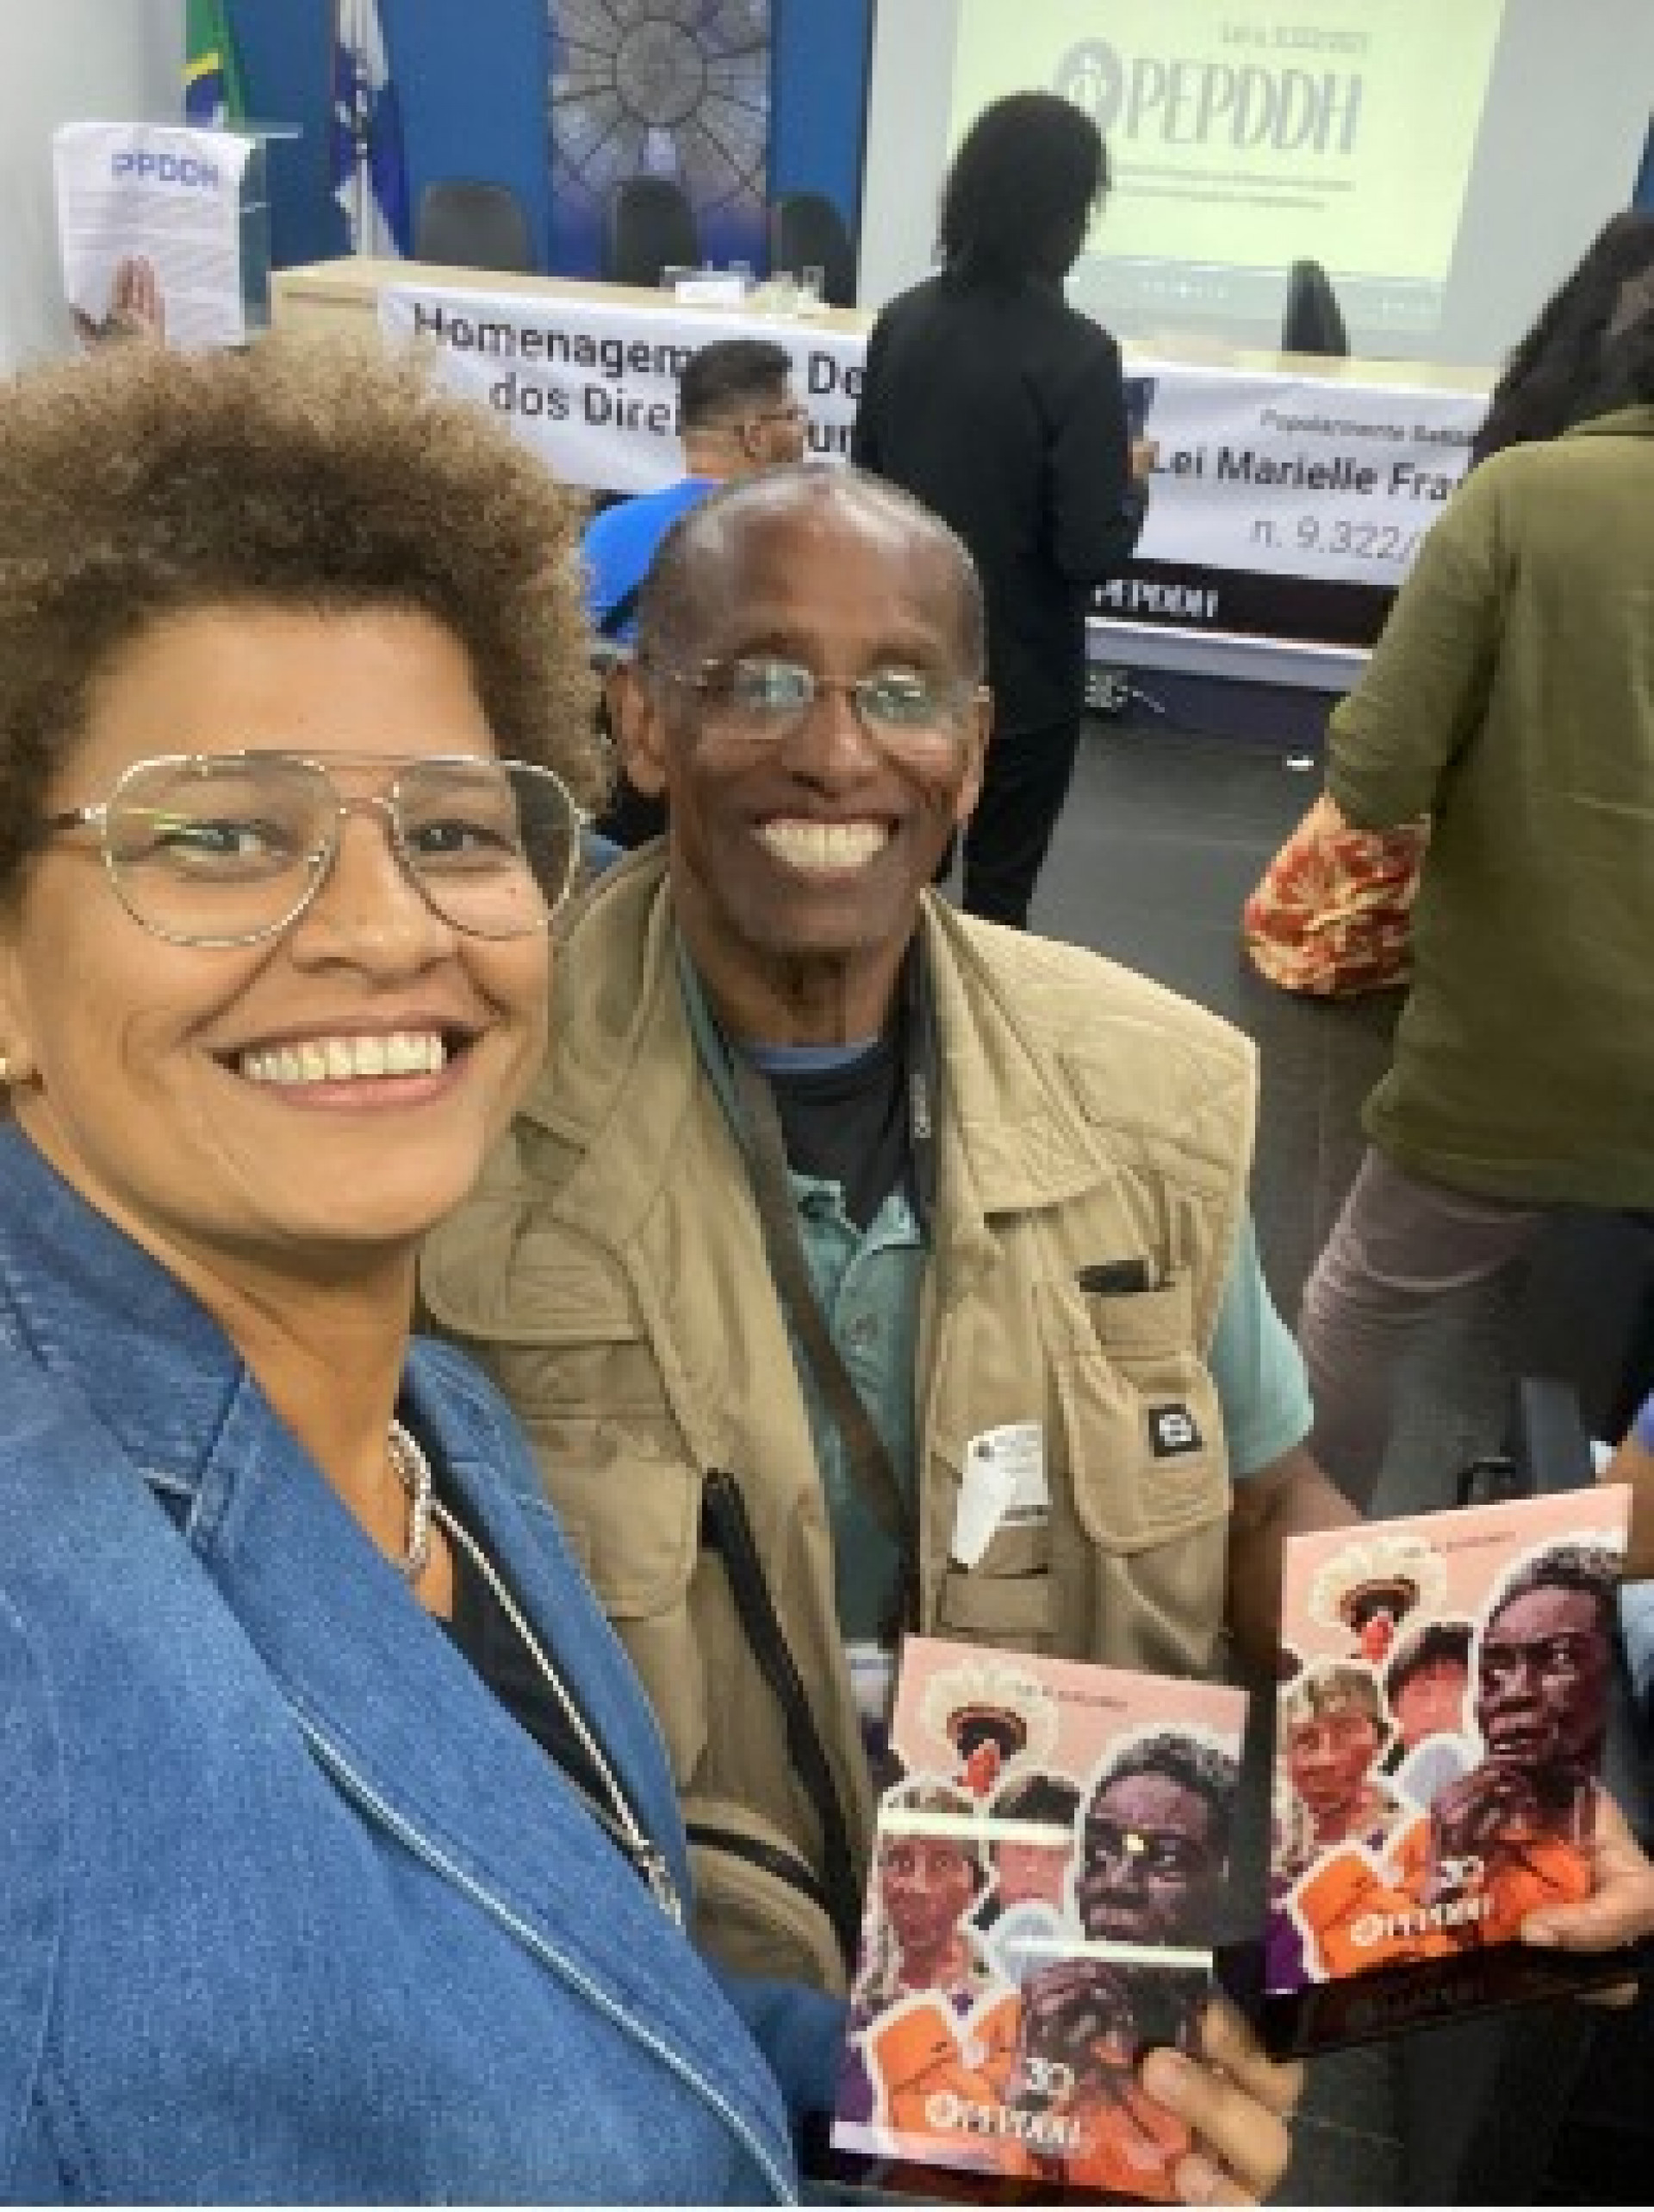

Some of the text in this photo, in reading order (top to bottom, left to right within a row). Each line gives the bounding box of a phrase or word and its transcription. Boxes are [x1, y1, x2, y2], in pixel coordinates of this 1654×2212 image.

[1125, 55, 1363, 155] PEPDDH
[490, 372, 570, 420] dos
[1217, 446, 1378, 495] Marielle
[1388, 462, 1464, 500] Fra
